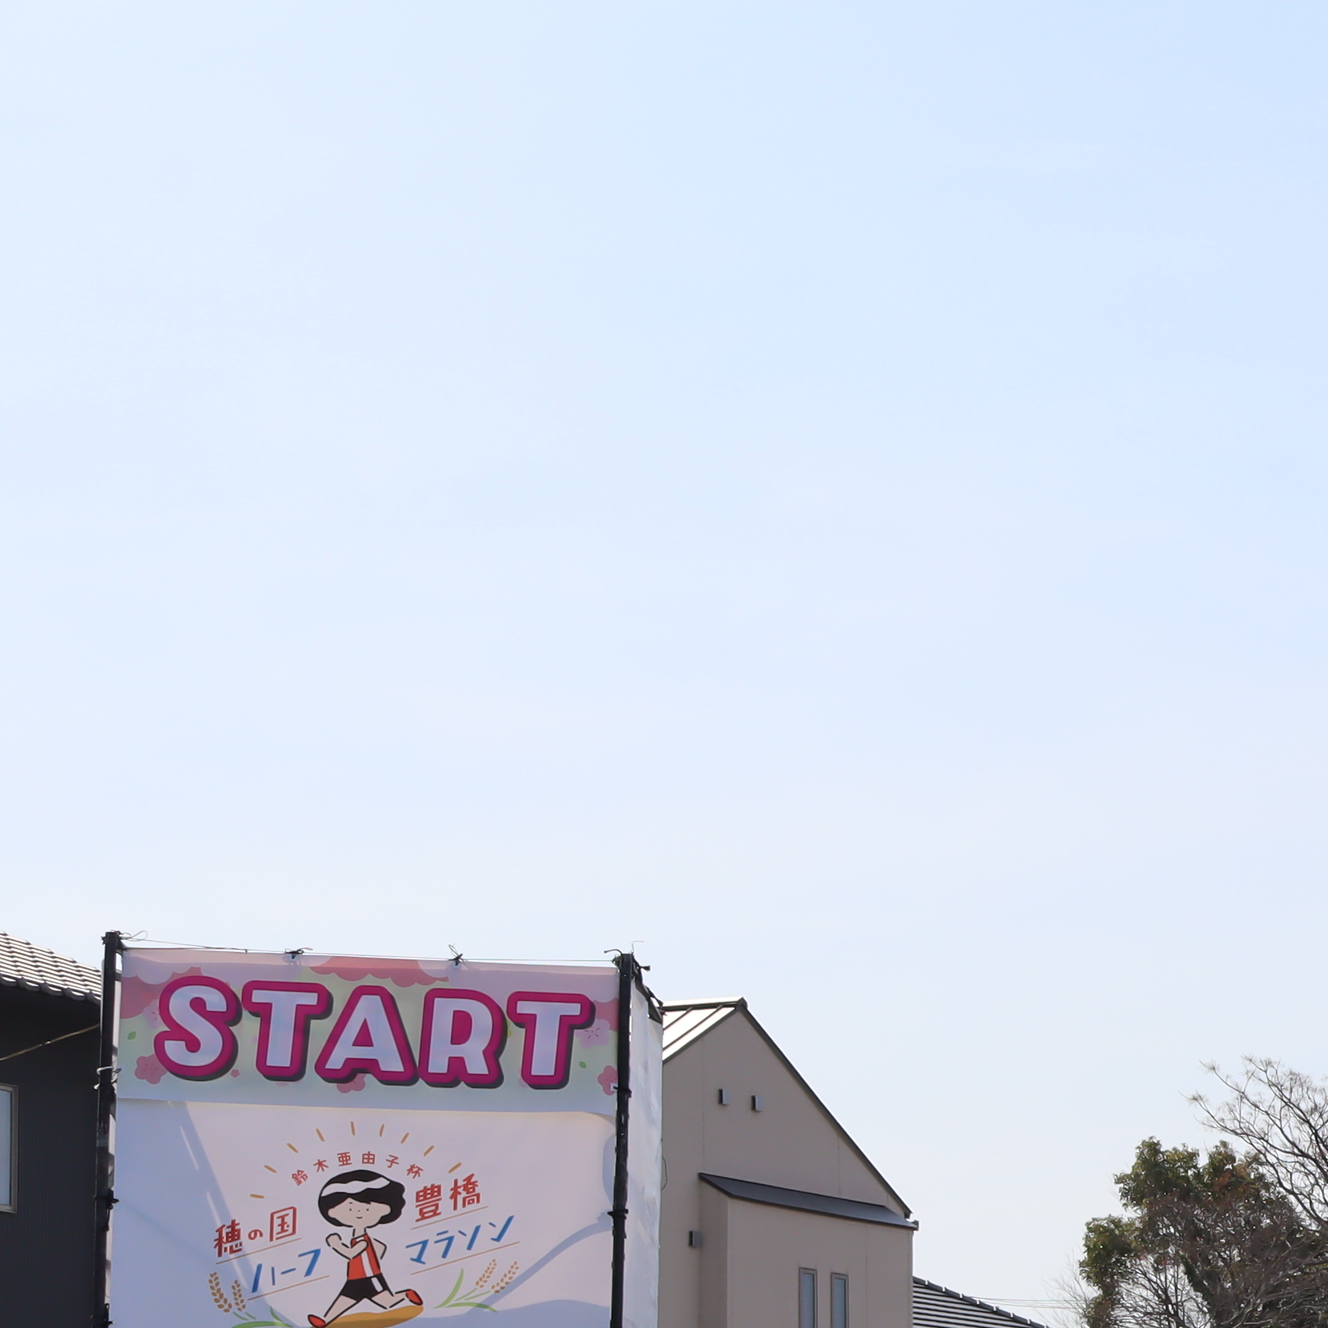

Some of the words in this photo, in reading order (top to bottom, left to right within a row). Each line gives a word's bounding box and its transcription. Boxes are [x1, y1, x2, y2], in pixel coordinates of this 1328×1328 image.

[154, 975, 596, 1089] START
[291, 1151, 425, 1187] 鈴木亜由子杯
[212, 1206, 298, 1258] 穂の国
[414, 1173, 481, 1223] 豊橋
[251, 1248, 322, 1294] ハーフ
[405, 1215, 516, 1265] マラソン
